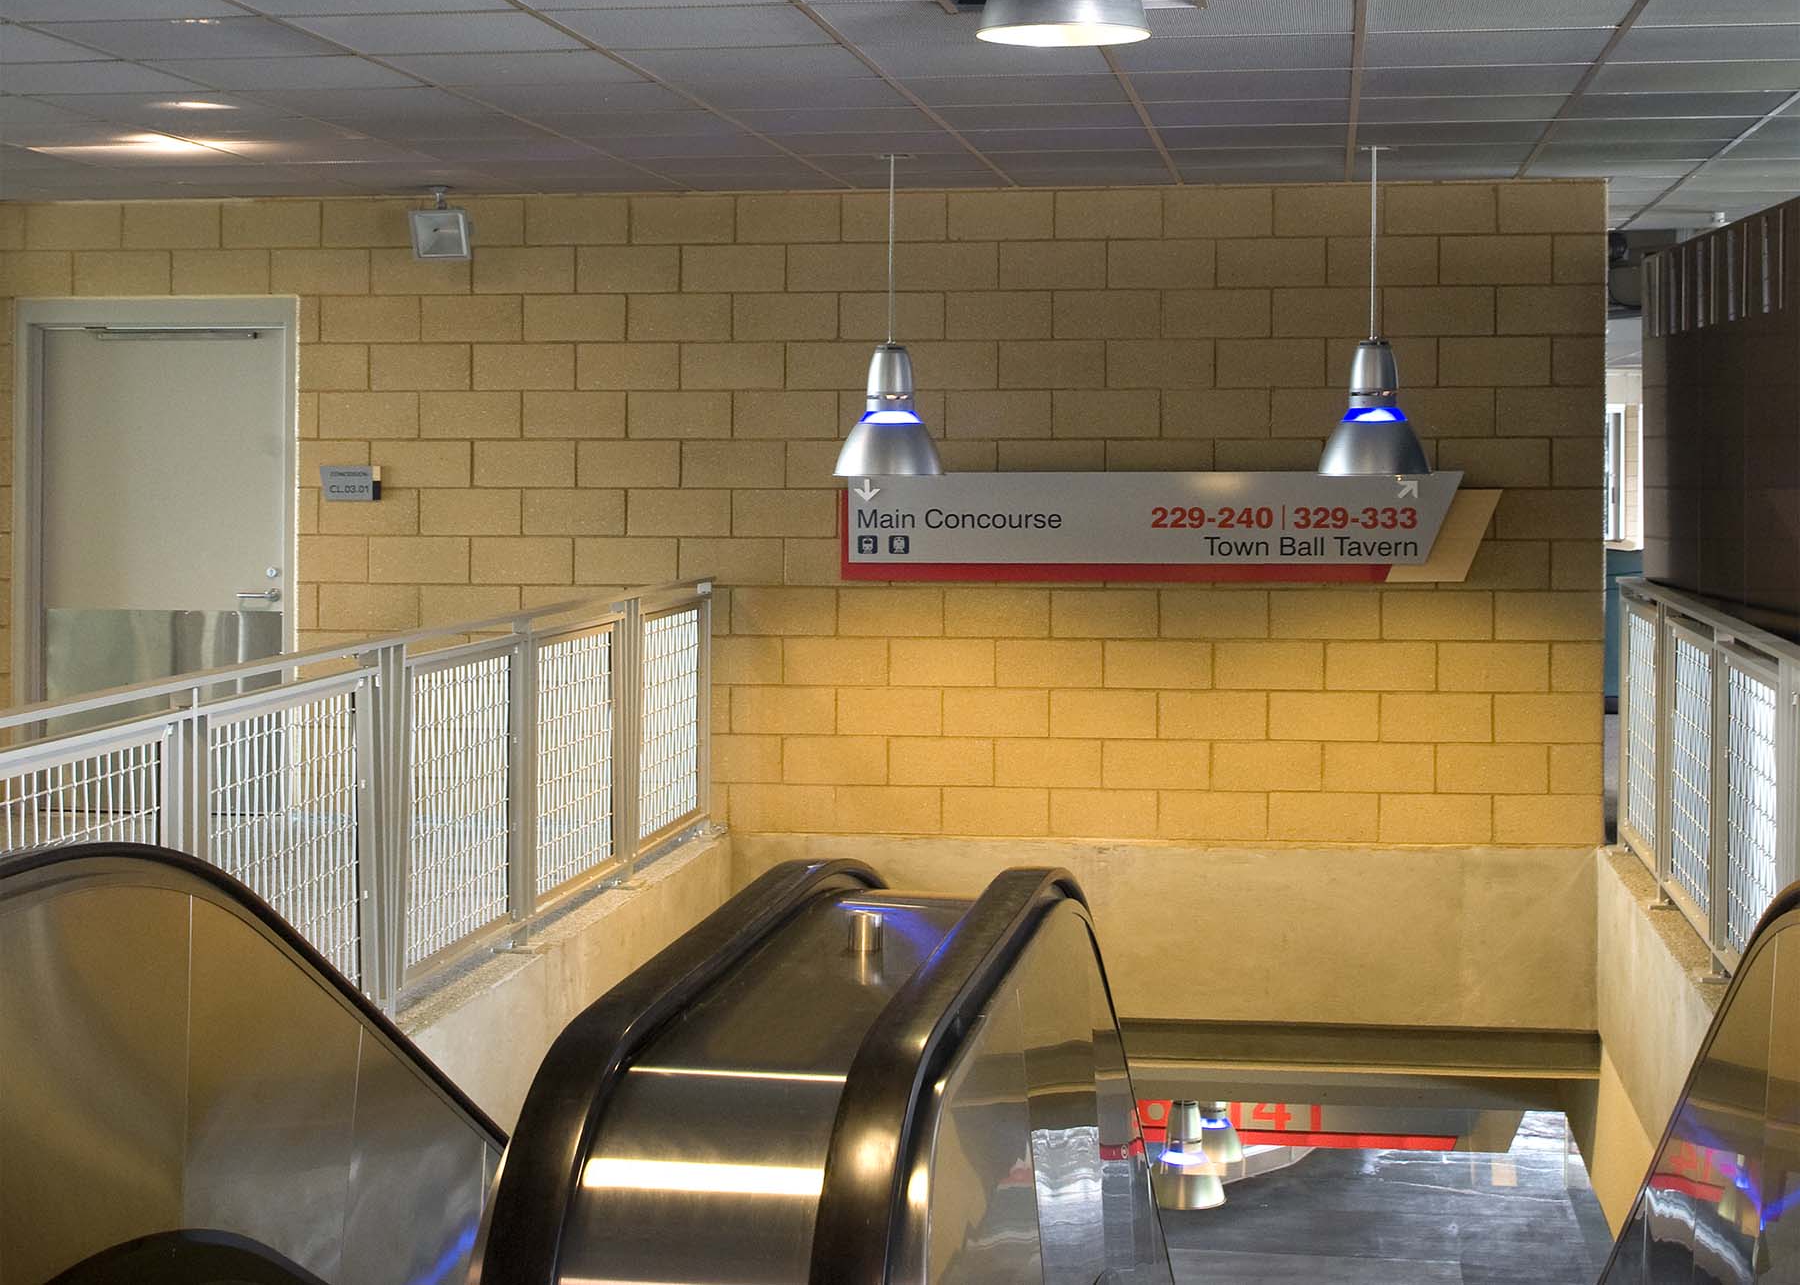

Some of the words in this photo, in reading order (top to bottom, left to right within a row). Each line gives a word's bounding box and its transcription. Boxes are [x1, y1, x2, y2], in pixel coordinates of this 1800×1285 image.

[857, 508, 915, 529] Main
[925, 508, 1062, 529] Concourse
[1151, 507, 1273, 529] 229-240
[1293, 507, 1418, 530] 329-333
[1204, 536, 1269, 557] Town
[1279, 536, 1325, 557] Ball
[1333, 536, 1418, 557] Tavern
